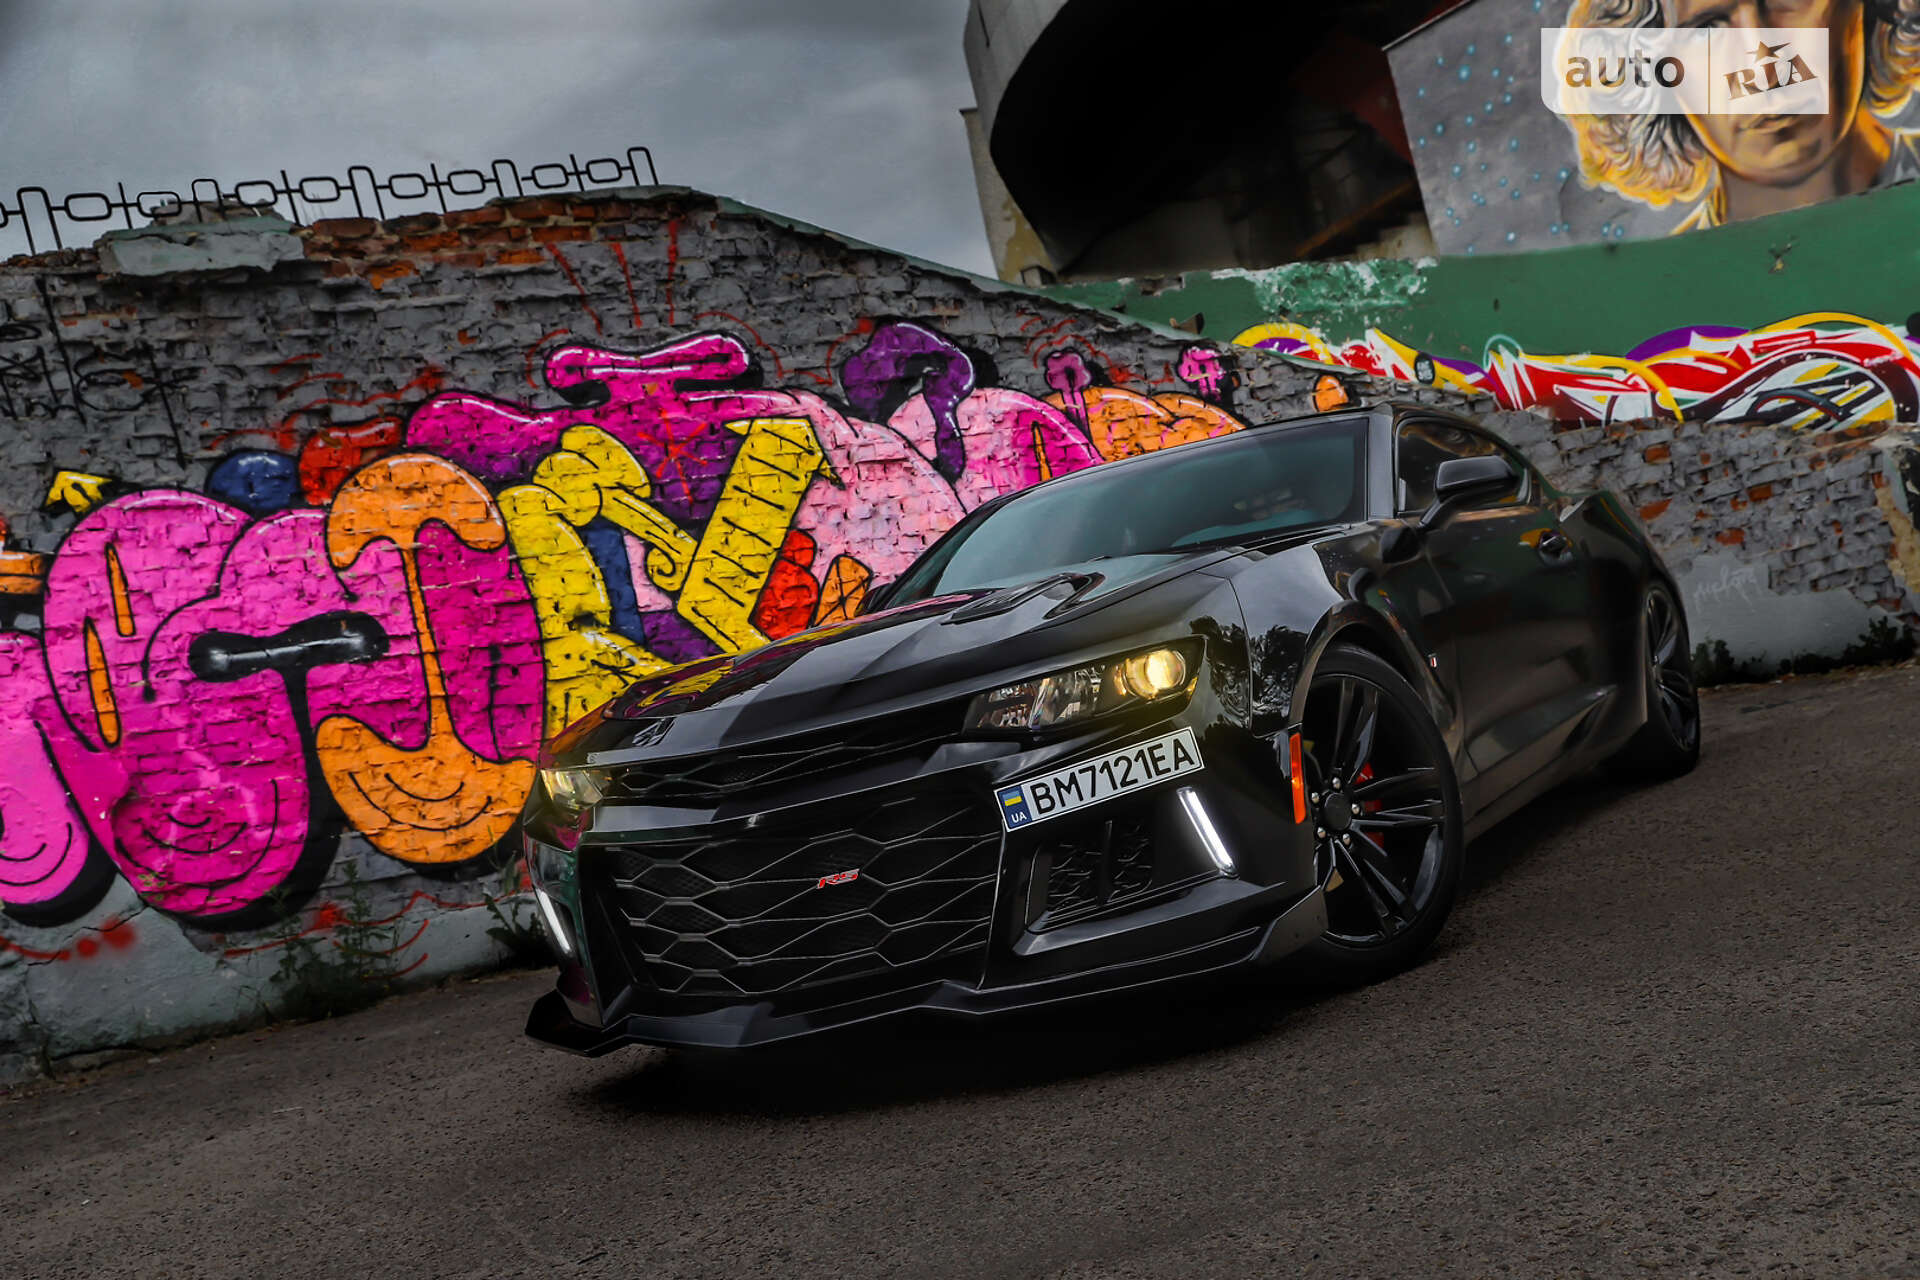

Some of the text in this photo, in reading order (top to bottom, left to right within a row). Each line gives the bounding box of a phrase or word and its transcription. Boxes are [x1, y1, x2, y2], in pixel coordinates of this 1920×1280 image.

[1030, 738, 1195, 815] BM7121EA
[1011, 811, 1028, 824] UA
[816, 868, 860, 889] RS
